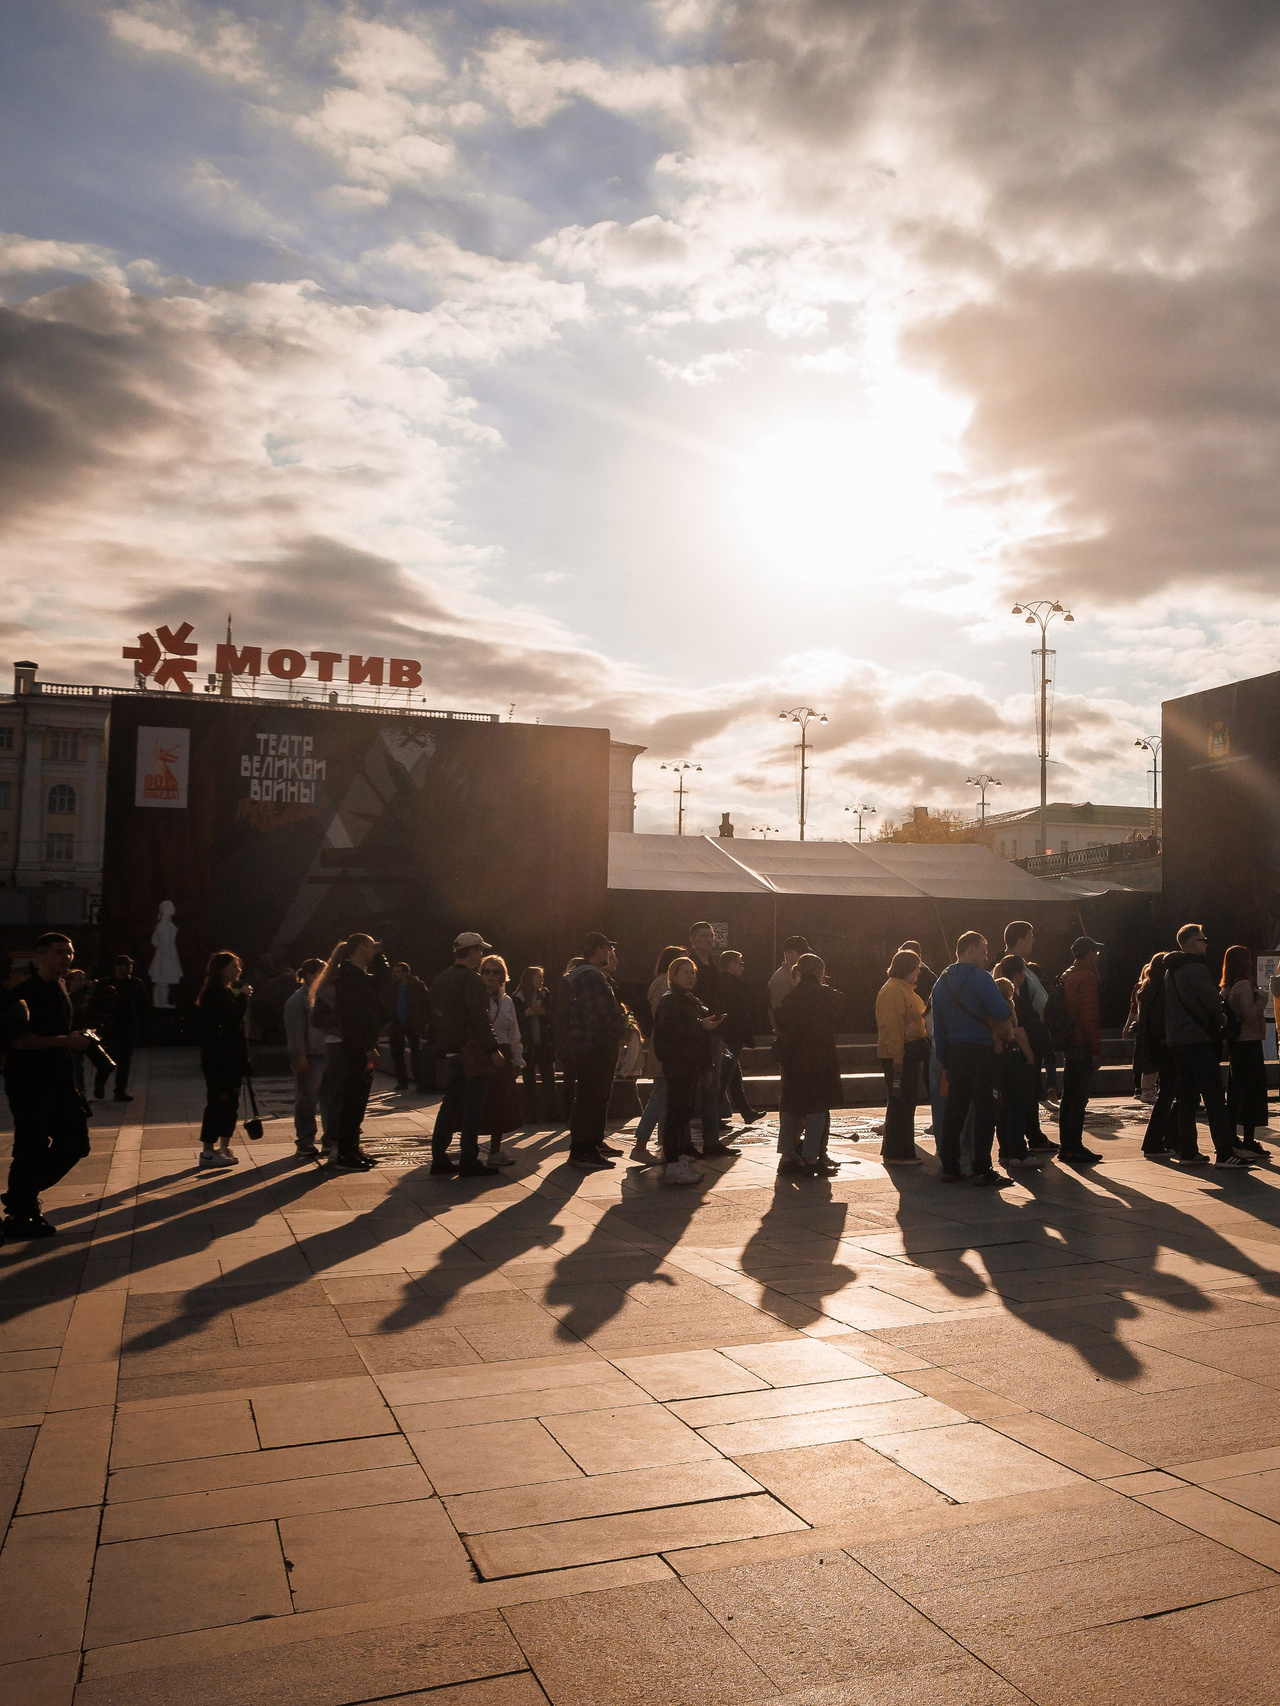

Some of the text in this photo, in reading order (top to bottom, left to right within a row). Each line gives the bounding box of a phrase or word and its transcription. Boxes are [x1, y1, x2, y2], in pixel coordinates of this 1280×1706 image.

[216, 643, 423, 689] МОТИВ
[256, 732, 314, 757] ТЕАТР
[250, 778, 316, 804] ВОЙНЫ
